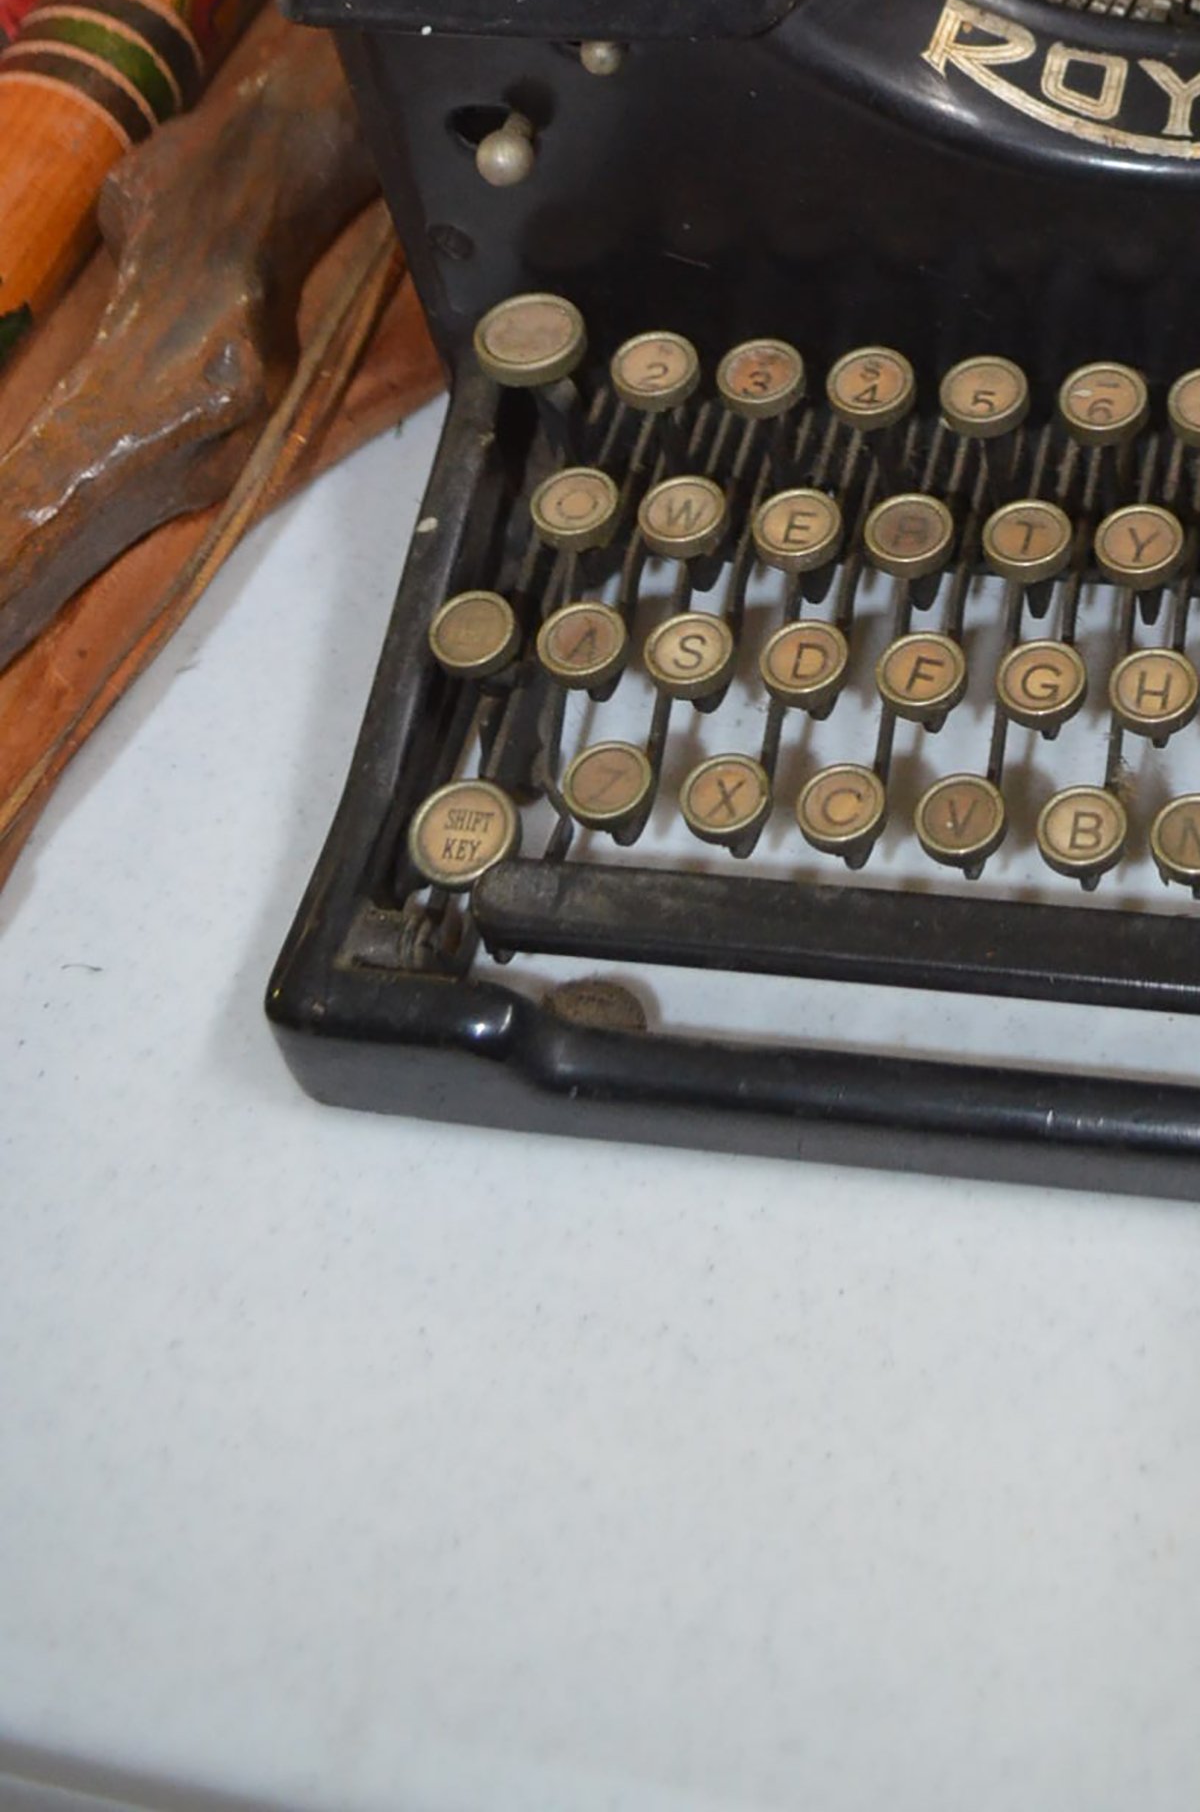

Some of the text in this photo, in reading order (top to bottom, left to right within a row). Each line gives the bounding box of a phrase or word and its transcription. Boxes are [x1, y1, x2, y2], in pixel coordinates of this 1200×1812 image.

[851, 383, 880, 405] 4
[971, 390, 997, 415] 5
[663, 497, 704, 532] W
[782, 509, 816, 545] E
[1014, 519, 1047, 556] T
[1127, 526, 1162, 564] Y
[563, 615, 600, 664] A
[673, 633, 708, 670] S
[790, 641, 830, 681] D
[905, 654, 945, 691] F
[1020, 663, 1064, 702] G
[1135, 669, 1174, 711] H
[704, 775, 746, 821] X
[821, 787, 864, 827] C
[443, 807, 496, 834] SHIFT
[946, 798, 980, 840] V
[1068, 811, 1105, 851] B
